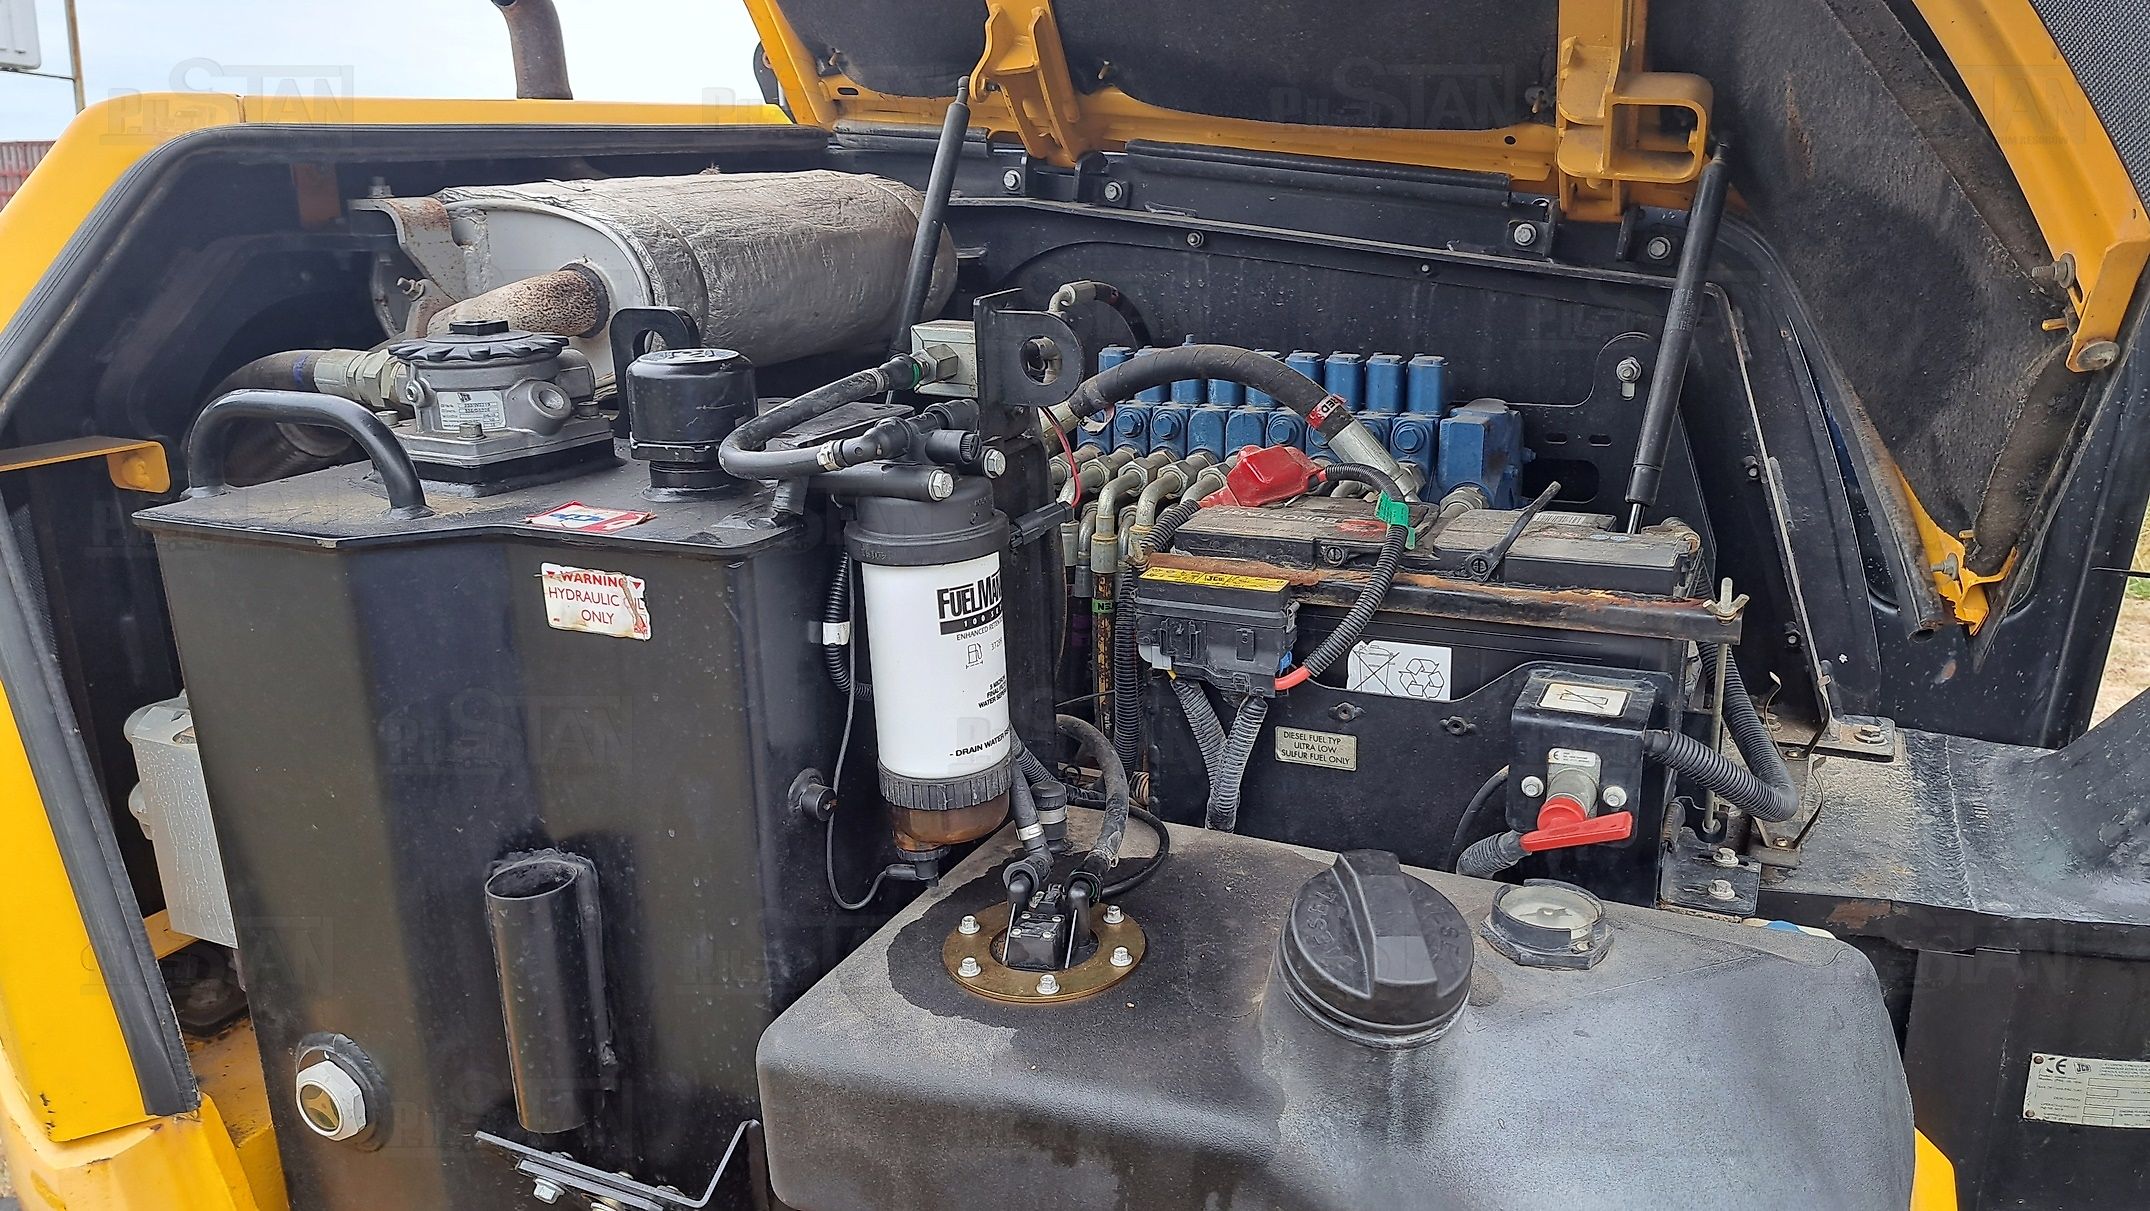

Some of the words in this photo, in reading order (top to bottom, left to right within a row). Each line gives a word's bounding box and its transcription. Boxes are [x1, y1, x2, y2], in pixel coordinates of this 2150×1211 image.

[548, 586, 620, 606] HYDRAULIC
[581, 609, 615, 625] ONLY
[956, 625, 989, 641] ENHANCED
[978, 697, 997, 709] WATER
[955, 743, 983, 757] DRAIN
[983, 731, 1005, 749] WATER
[1283, 731, 1307, 741] DIESEL
[1309, 734, 1326, 744] FUEL
[1293, 741, 1316, 752] ULTRA
[1317, 745, 1338, 754] LOW
[1281, 748, 1308, 760] SULFUR
[1309, 752, 1327, 763] FUEL
[1328, 755, 1351, 765] ONLY
